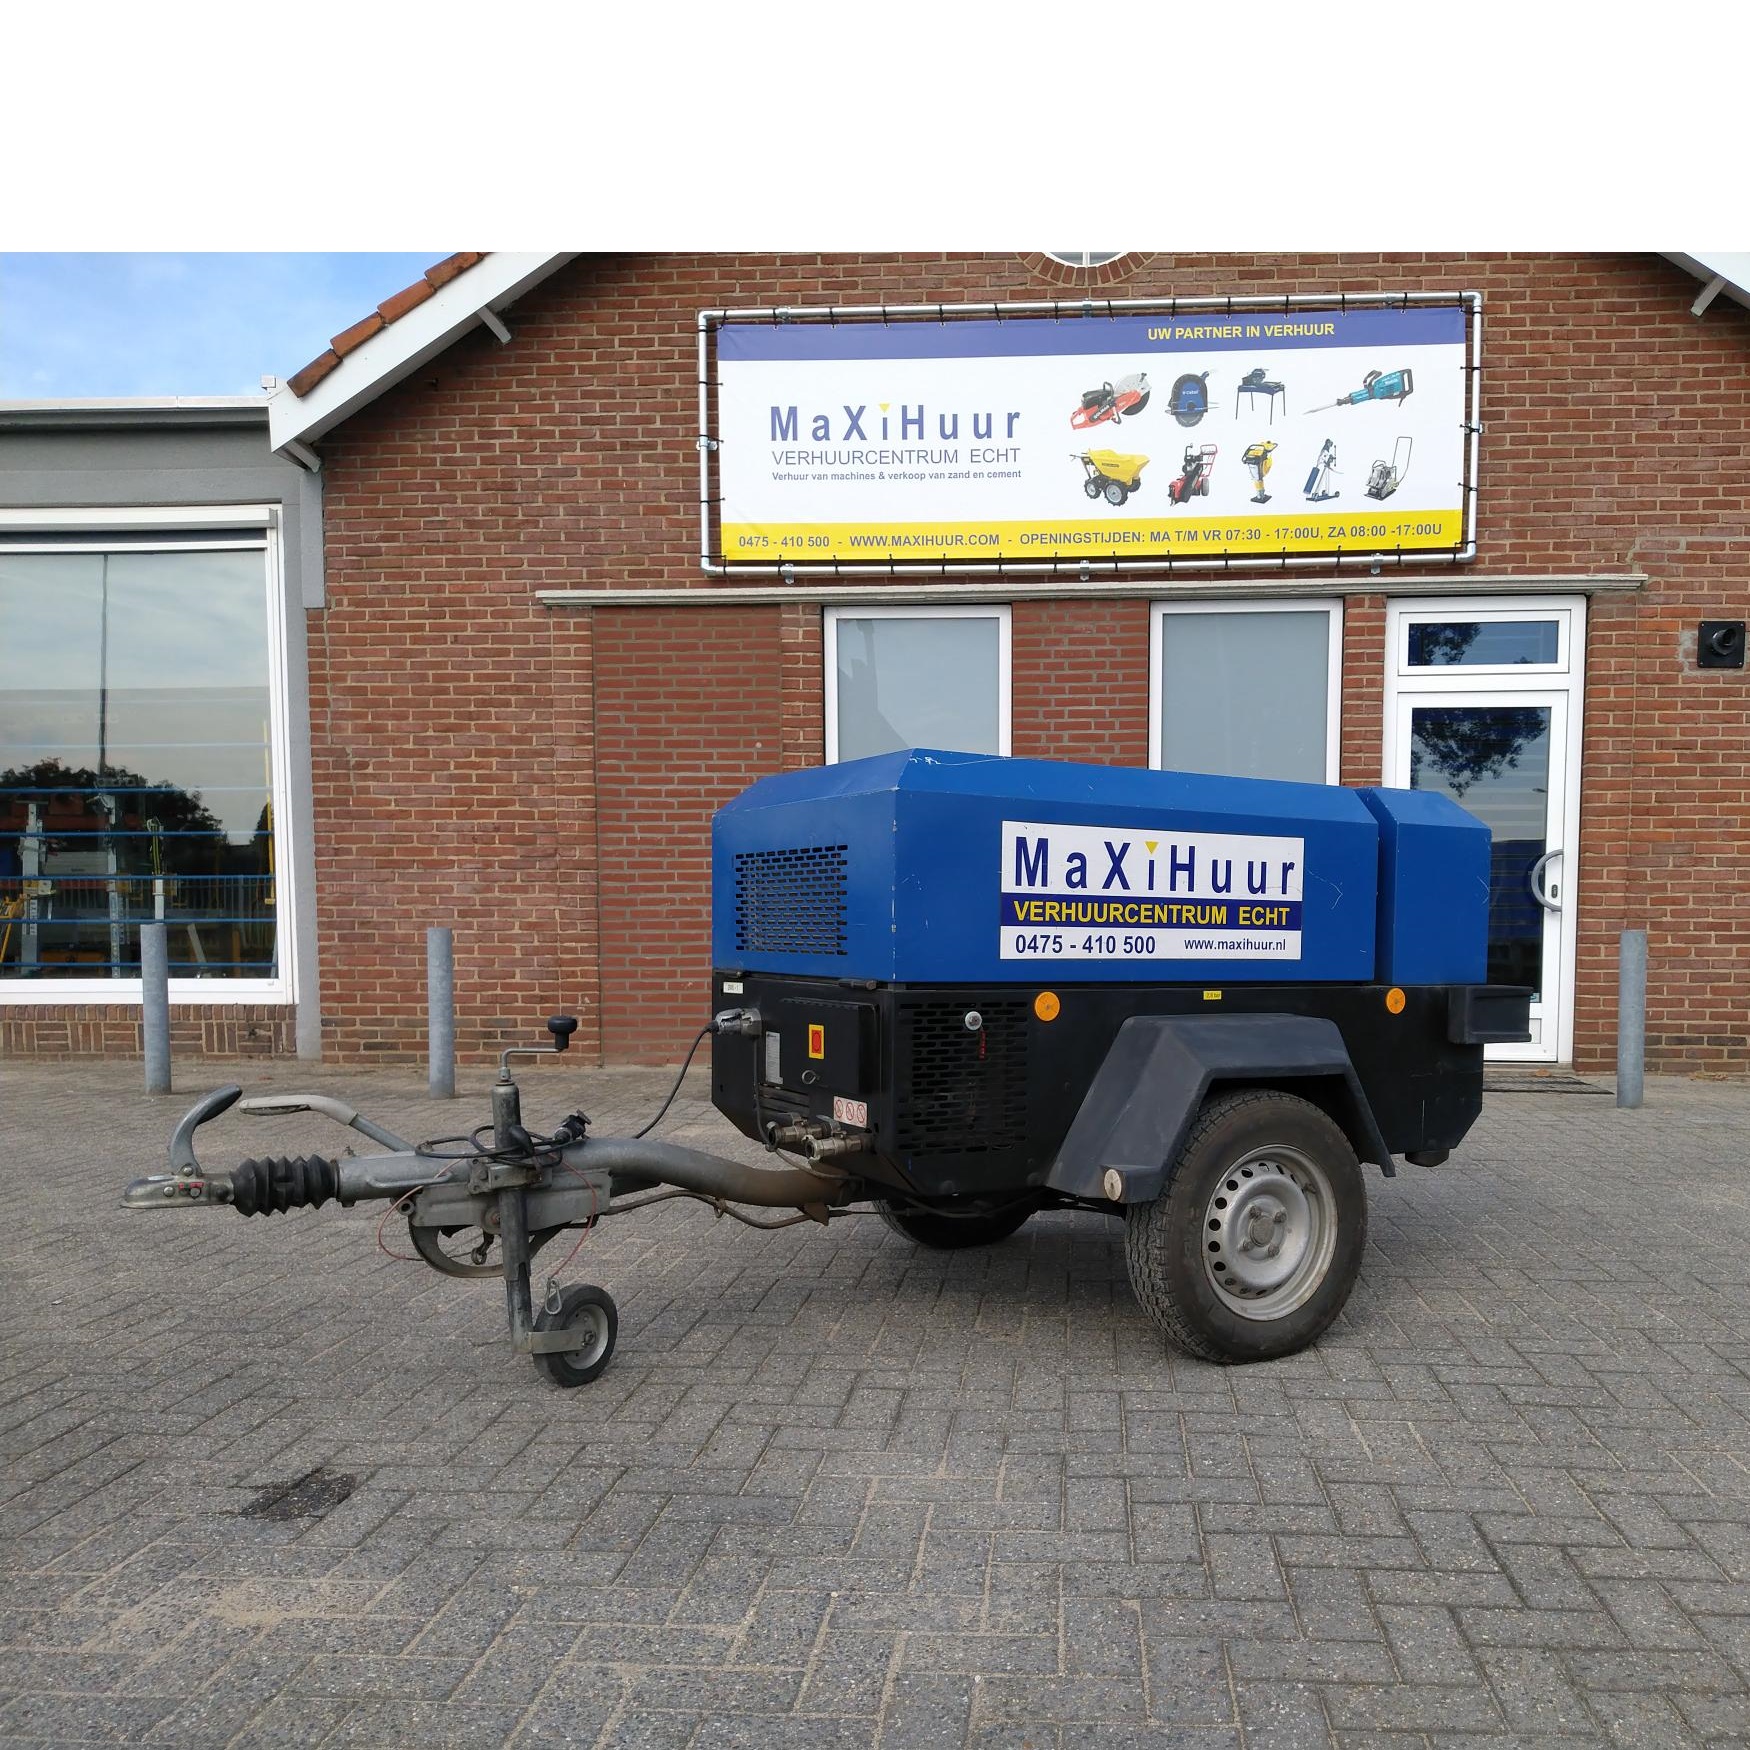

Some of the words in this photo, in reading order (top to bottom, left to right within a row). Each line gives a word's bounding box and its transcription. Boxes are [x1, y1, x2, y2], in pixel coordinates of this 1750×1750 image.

[1147, 328, 1171, 340] UW
[1175, 326, 1242, 339] PARTNER
[1246, 325, 1260, 337] IN
[1263, 323, 1335, 336] VERHUUR
[771, 403, 1021, 441] MaXiHuur
[771, 449, 959, 465] VERHUURCENTRUM
[970, 448, 1021, 463] ECHT
[772, 472, 810, 481] Verhuur
[830, 472, 876, 480] machines
[878, 472, 886, 480] &
[888, 471, 926, 481] verkoop
[947, 471, 970, 479] zand
[986, 470, 1022, 478] cement
[739, 535, 769, 547] 0475
[781, 535, 803, 547] 410
[807, 535, 830, 547] 500
[849, 534, 1000, 547] WWW.MAXIHUUR.COM
[1020, 531, 1146, 545] OPENINGSTIJDEN:
[1150, 530, 1171, 542] MA
[1175, 530, 1198, 542] T/M
[1202, 529, 1222, 541] VR
[1225, 528, 1261, 540] 07:30
[1274, 527, 1324, 541] 17:00U,
[1328, 526, 1347, 538] ZA
[1350, 525, 1386, 537] 08:00
[1015, 836, 1295, 895] MaXiHuur
[1013, 900, 1227, 925] VERHUURCENTRUM
[1238, 906, 1290, 926] ECHT
[1015, 934, 1063, 953] 0475
[1082, 935, 1116, 954] 410
[1123, 935, 1156, 954] 500
[1184, 938, 1286, 951] www.maxihuur.nl
